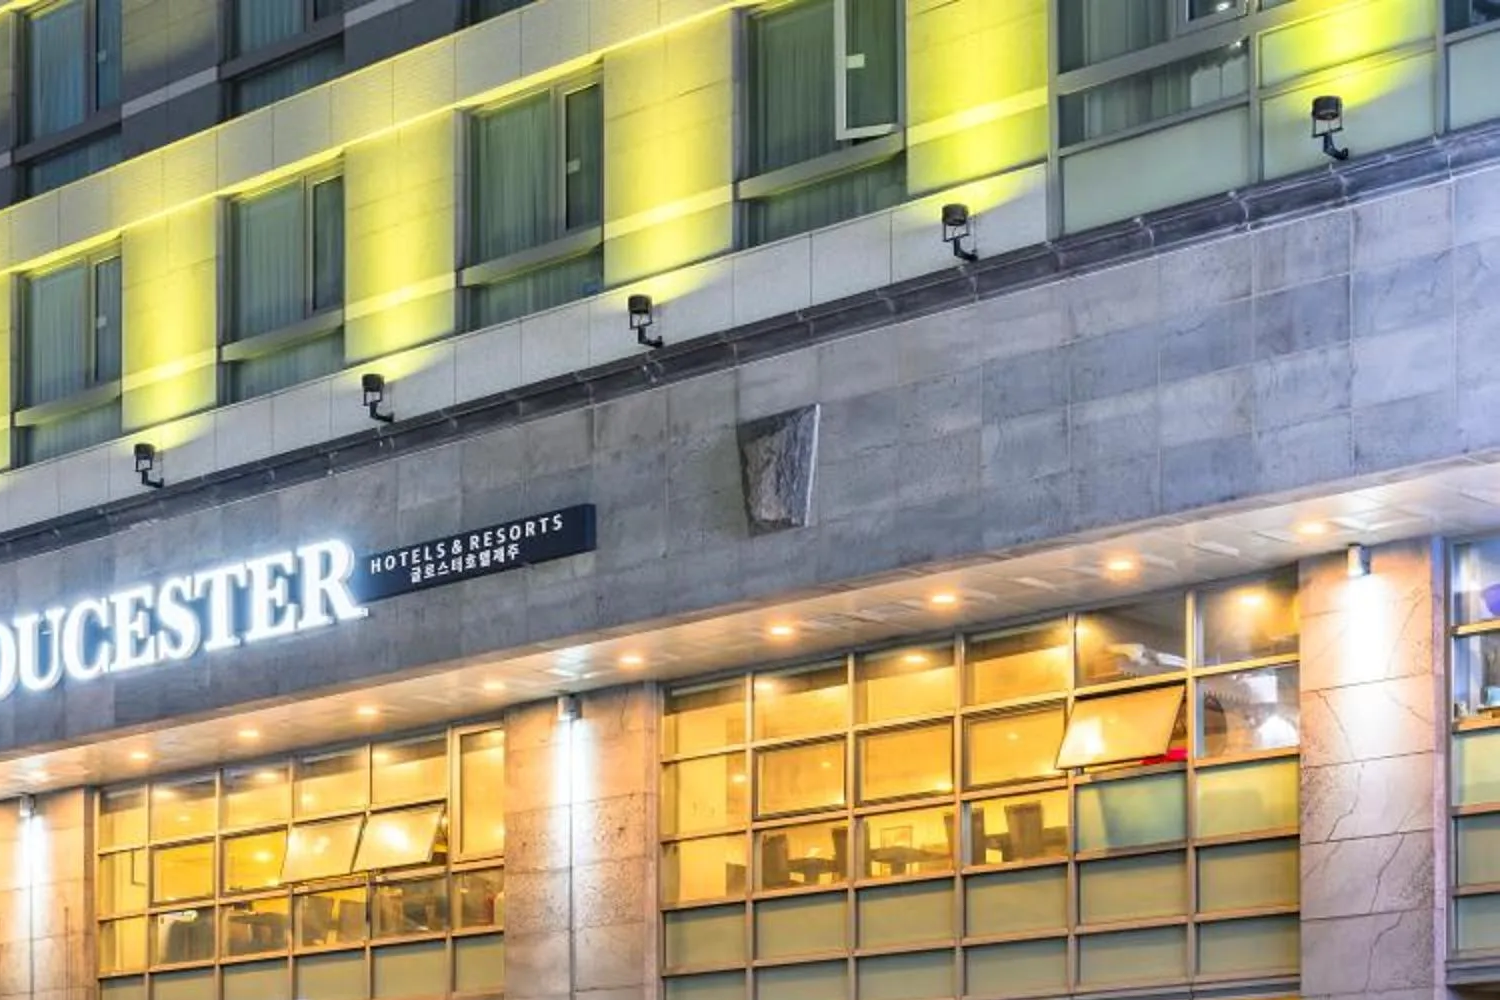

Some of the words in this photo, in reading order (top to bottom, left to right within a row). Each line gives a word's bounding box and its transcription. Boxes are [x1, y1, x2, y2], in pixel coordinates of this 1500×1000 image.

[370, 542, 445, 575] HOTELS
[451, 539, 463, 555] &
[469, 513, 564, 551] RESORTS
